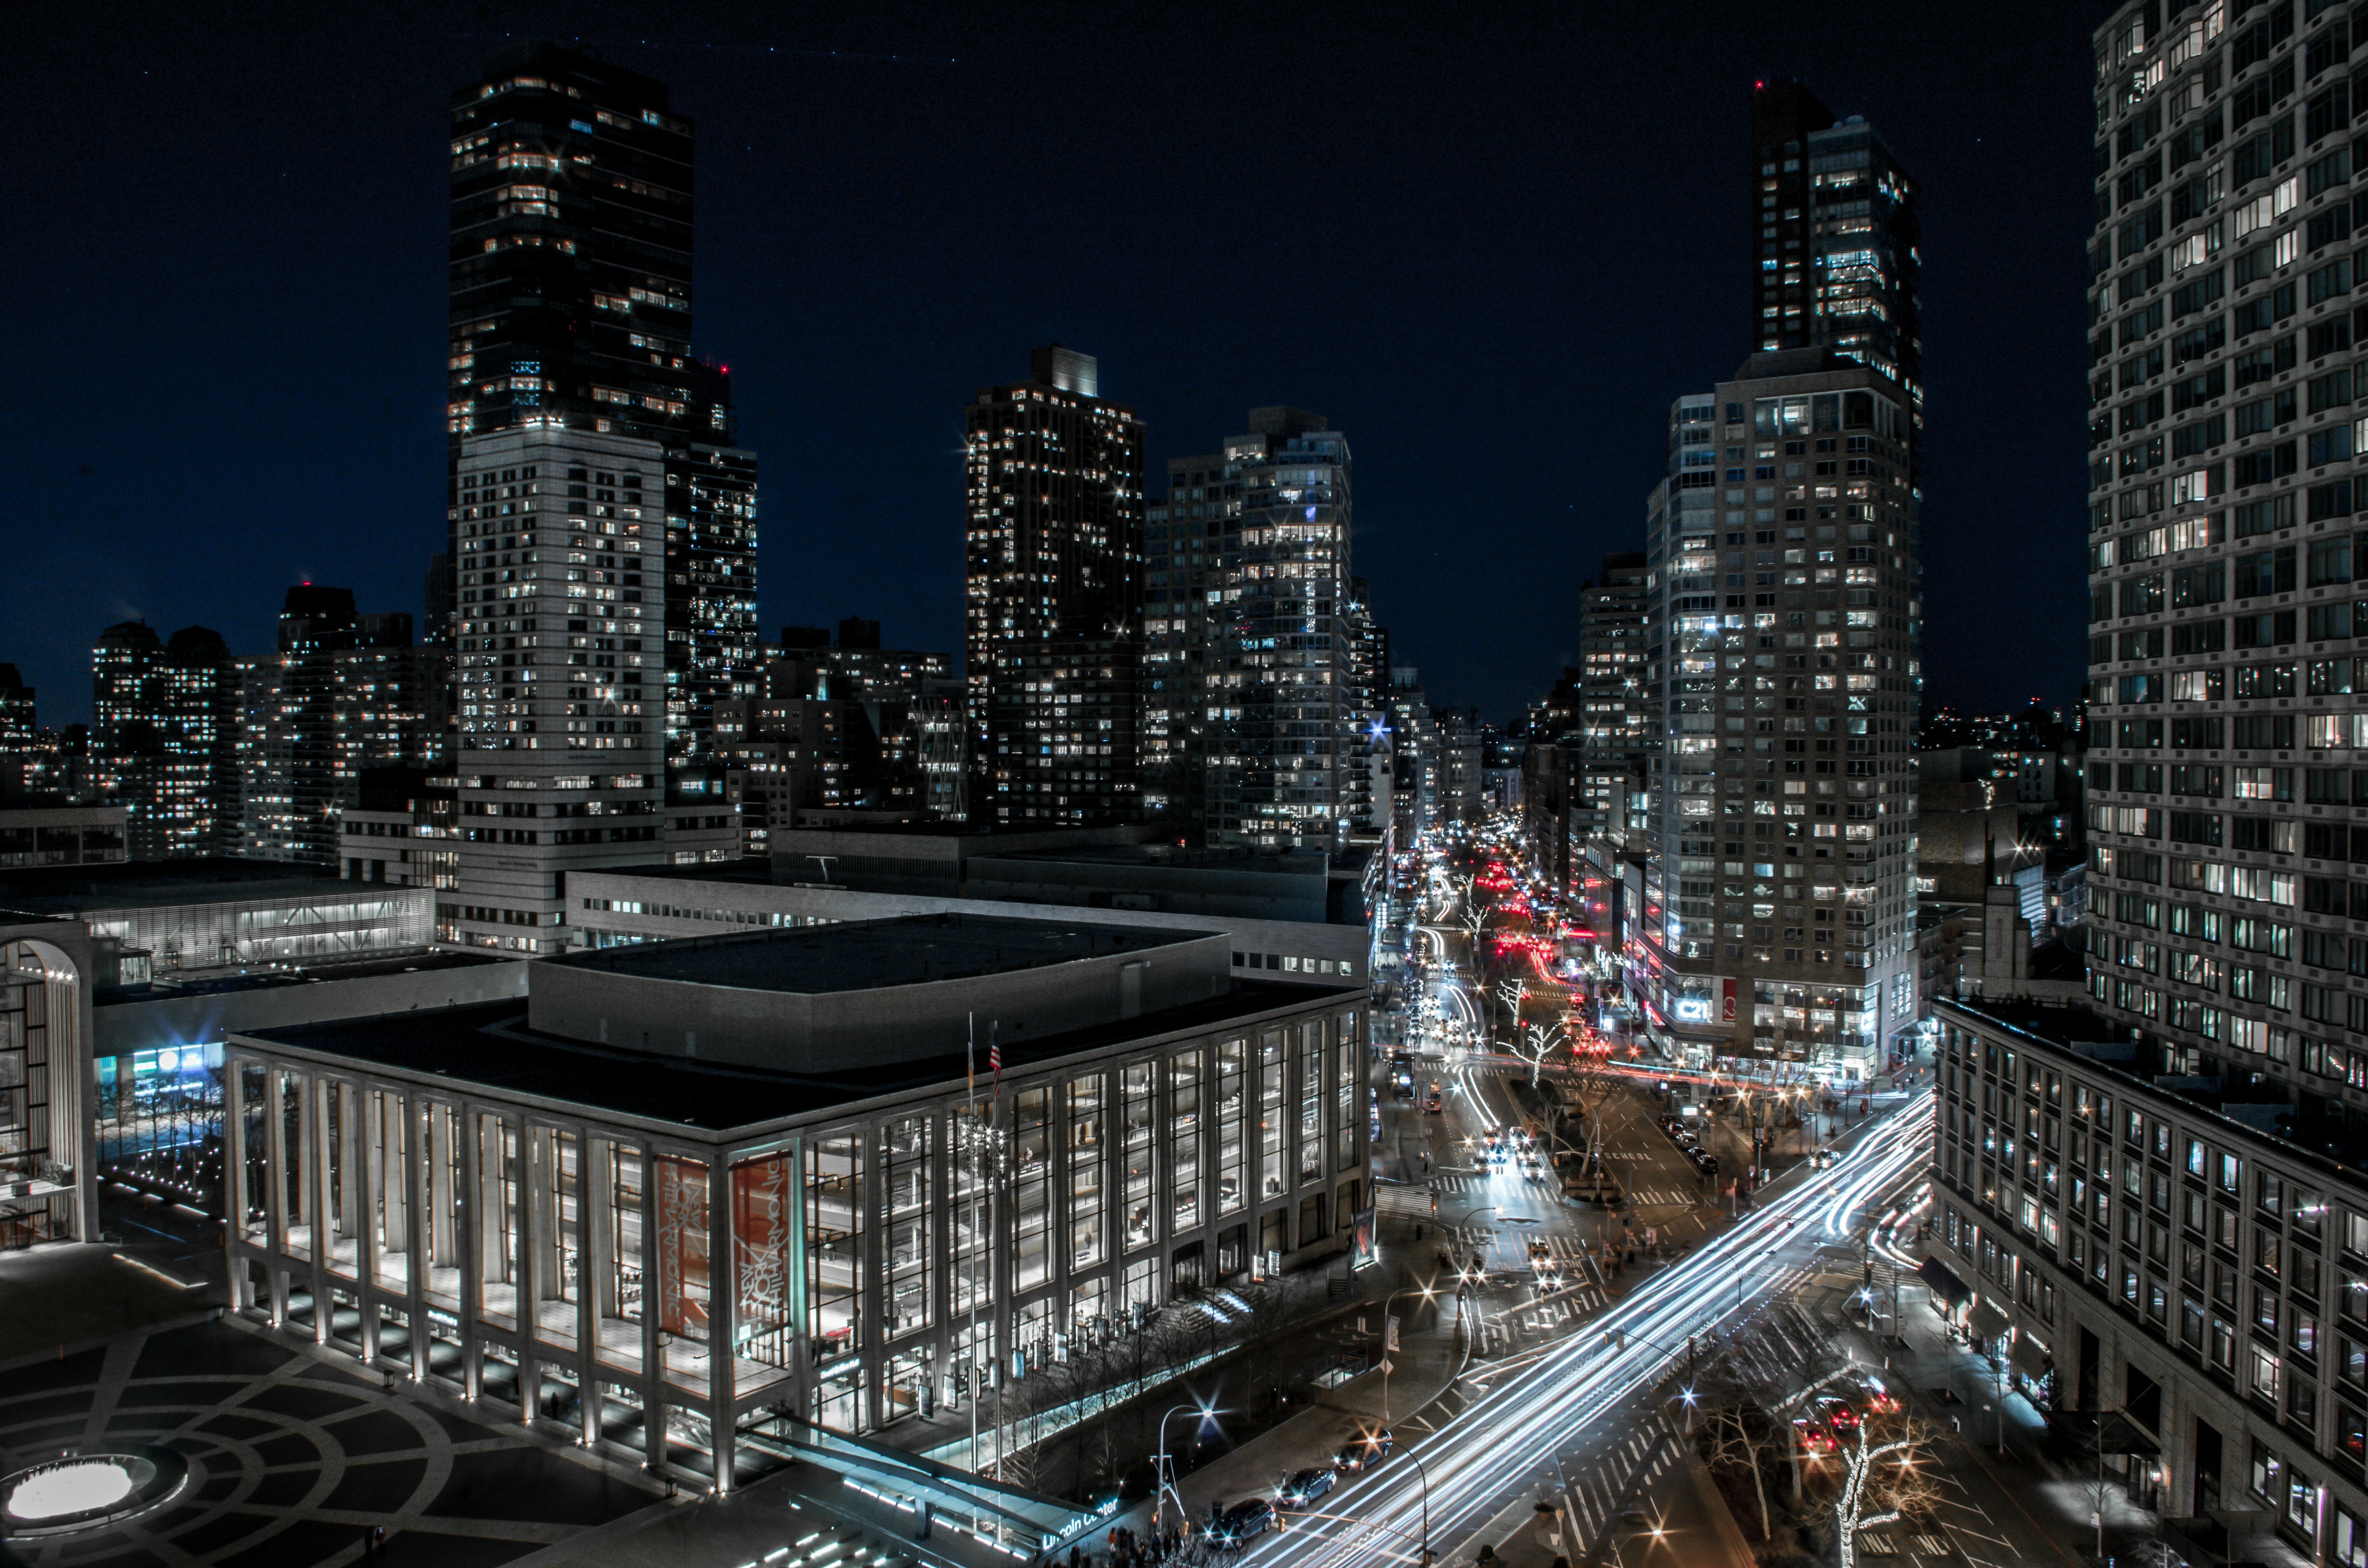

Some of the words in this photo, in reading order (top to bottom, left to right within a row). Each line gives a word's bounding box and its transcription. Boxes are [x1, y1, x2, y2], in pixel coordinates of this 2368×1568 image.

[1679, 1001, 1708, 1018] C21
[1724, 996, 1736, 1021] C21
[690, 1185, 704, 1232] NEW
[660, 1162, 683, 1317] PHILHARMONIC
[762, 1159, 789, 1314] PHILHARMONIC
[739, 1262, 754, 1307] NEW
